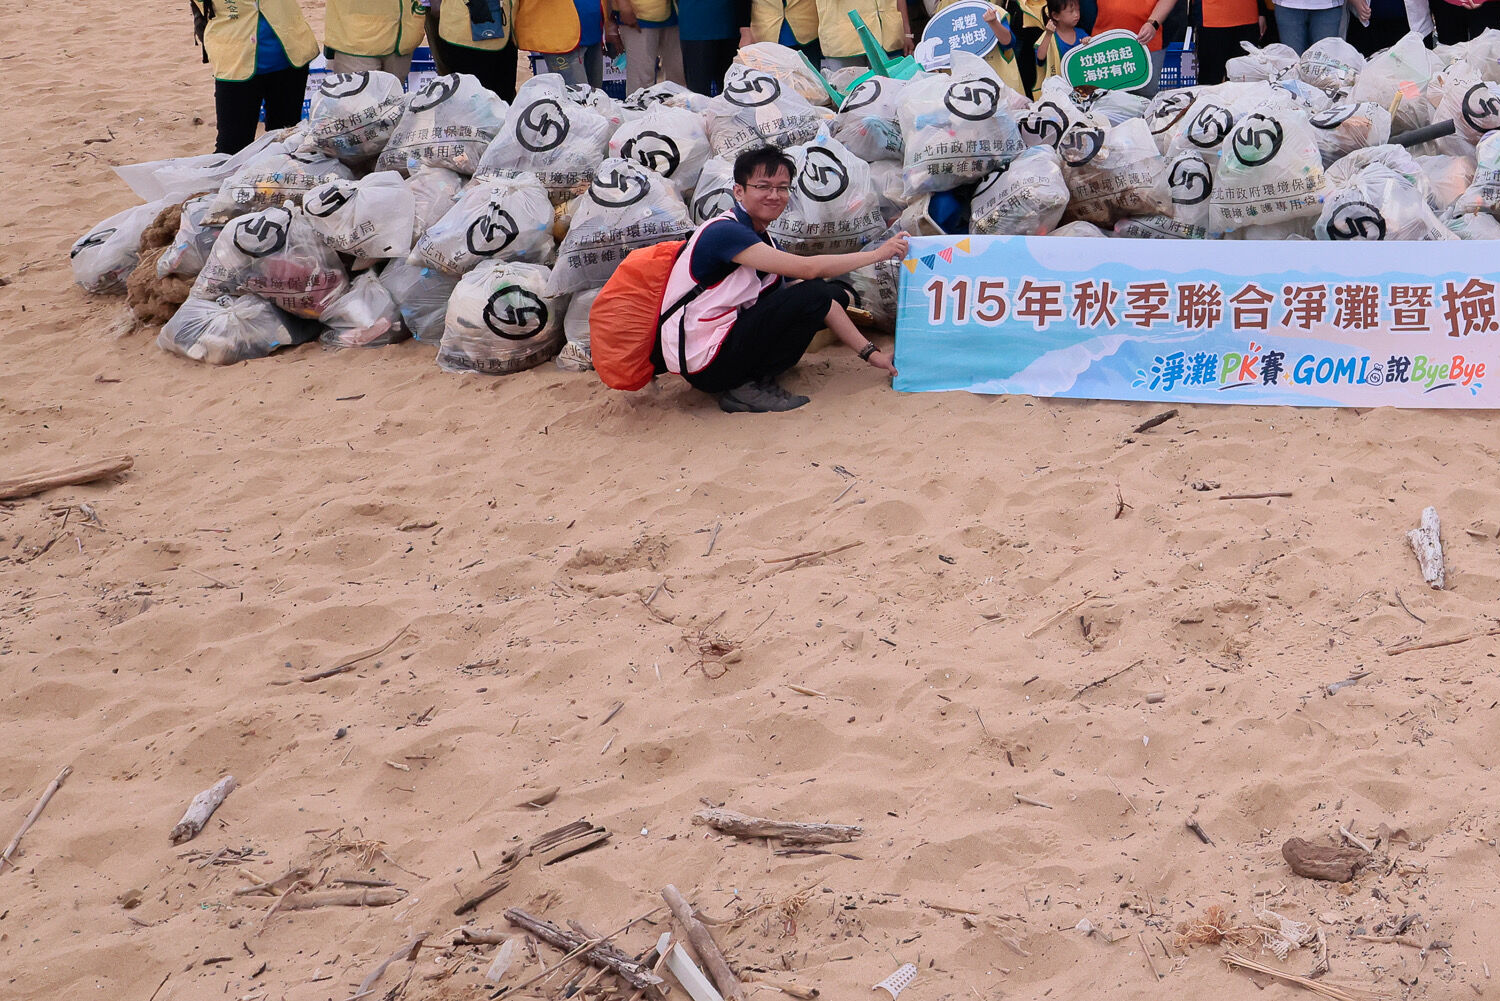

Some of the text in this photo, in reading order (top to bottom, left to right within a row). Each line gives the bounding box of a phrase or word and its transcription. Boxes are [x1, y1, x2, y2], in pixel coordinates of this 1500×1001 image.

[951, 13, 978, 32] 減塑
[948, 28, 988, 50] 愛地球
[1080, 46, 1133, 68] 垃圾撿起
[1083, 61, 1136, 83] 海好有你
[1149, 347, 1286, 392] 淨灘PK賽
[1293, 354, 1369, 386] GOMI
